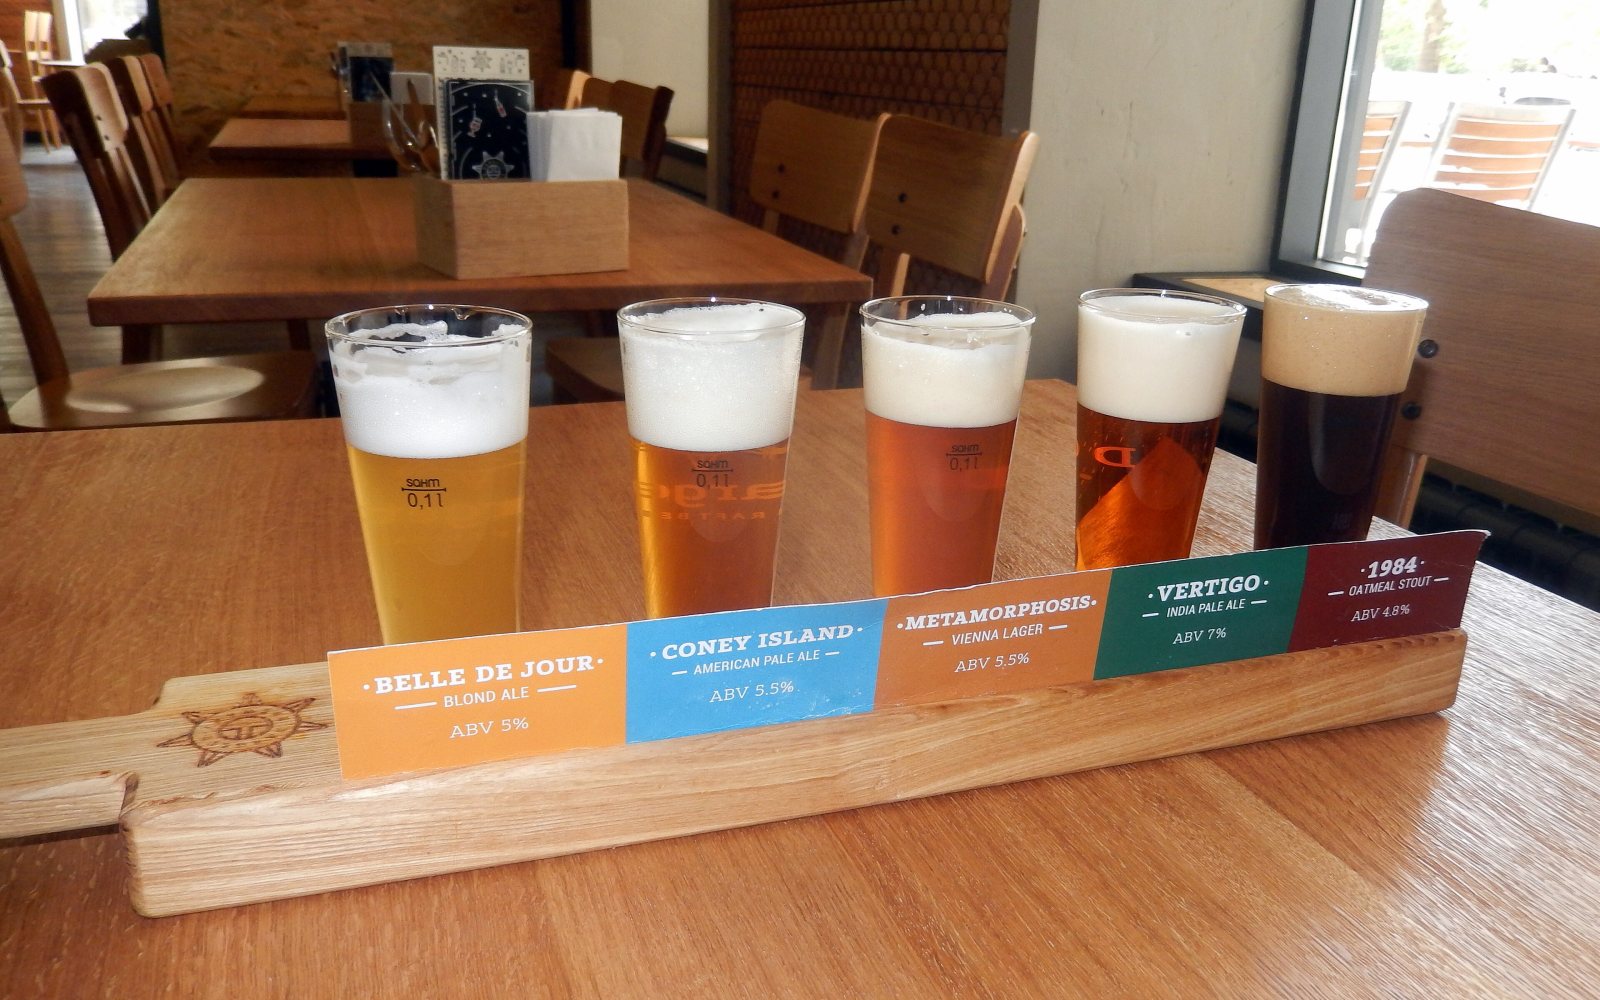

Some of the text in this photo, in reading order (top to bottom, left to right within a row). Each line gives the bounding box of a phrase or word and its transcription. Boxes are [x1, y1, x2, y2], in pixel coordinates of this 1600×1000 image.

[1367, 556, 1417, 579] 1984
[1157, 574, 1261, 602] VERTIGO
[1348, 575, 1433, 596] OATMEAL STOUT
[904, 595, 1091, 630] METAMORPHOSIS
[1166, 598, 1246, 618] INDIA PALE ALE
[1351, 604, 1410, 622] ABV 4.8%
[662, 624, 853, 660] CONEY ISLAND
[952, 623, 1043, 646] VIENNA LAGER
[1172, 627, 1227, 645] ABV 7%
[693, 650, 820, 676] AMERICAN PALE ALE
[954, 652, 1030, 673] ABV 5.5%
[375, 655, 595, 694] BELLE DE JOUR
[443, 686, 529, 708] BLOND ALE
[709, 681, 794, 703] ABV 5.5%
[449, 717, 529, 739] ABV 5%
